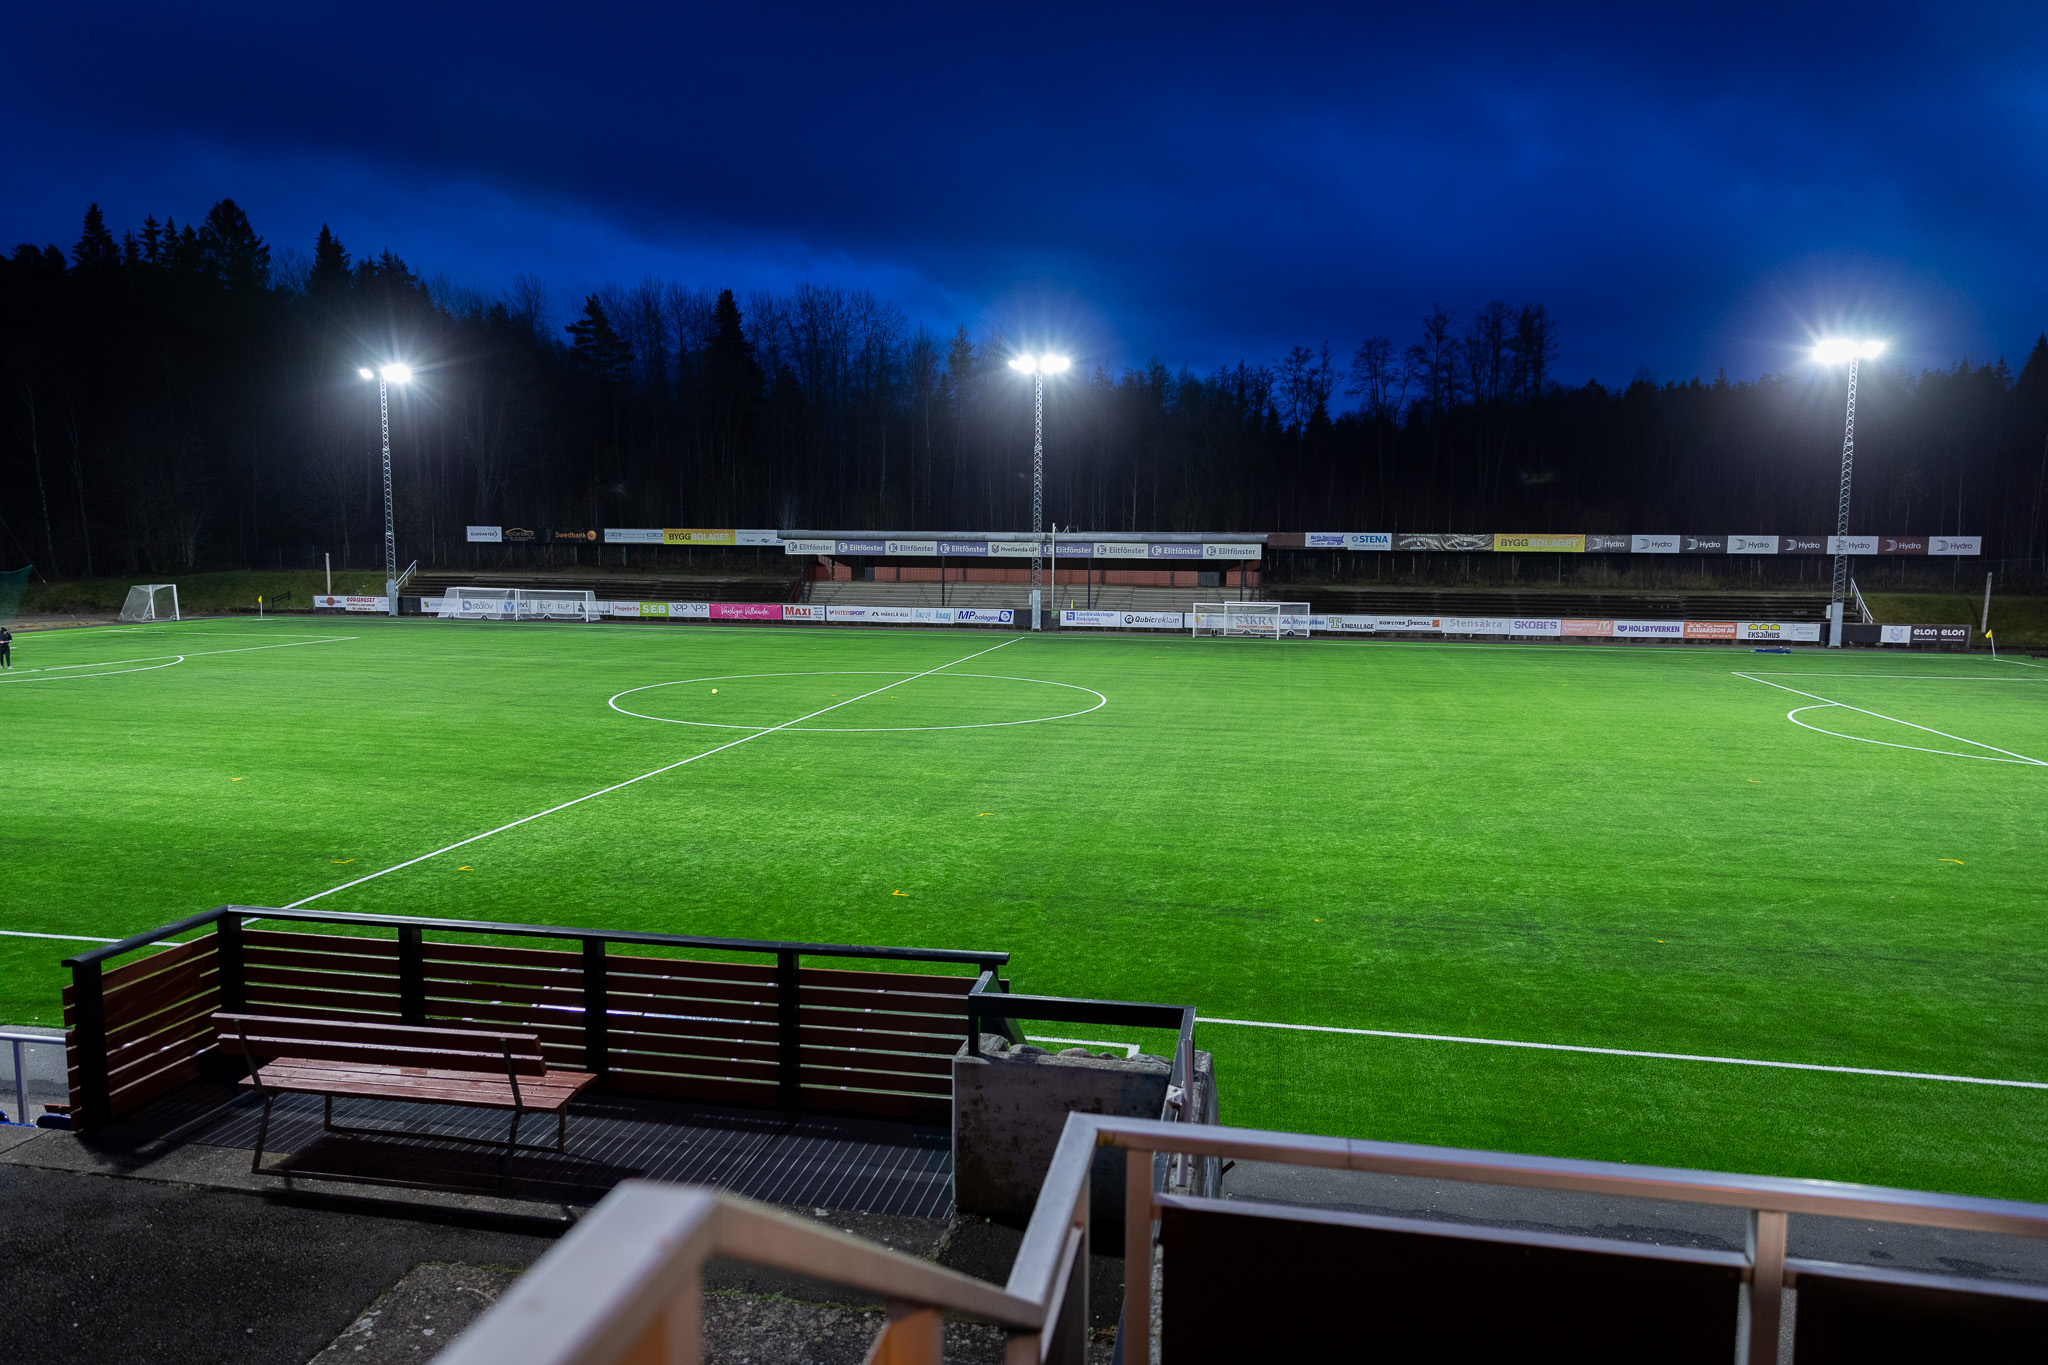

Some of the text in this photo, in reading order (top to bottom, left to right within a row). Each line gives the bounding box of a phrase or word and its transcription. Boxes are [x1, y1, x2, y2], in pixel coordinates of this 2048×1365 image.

[555, 531, 587, 539] Swedbank
[1360, 535, 1388, 544] STENA
[799, 543, 833, 551] Elitfönster
[849, 543, 883, 552] Elitfönster
[900, 544, 934, 552] Elitfönster
[951, 544, 987, 553] Elitfönster
[1748, 541, 1770, 549] Hydro
[1899, 542, 1921, 550] Hydro
[1950, 542, 1973, 550] Hydro
[1056, 546, 1092, 554] Elitfönster
[1108, 546, 1145, 554] Elitfönster
[1163, 547, 1200, 555] Elitfönster
[1218, 547, 1256, 556] Elitfönster
[642, 604, 666, 614] SEB
[1134, 615, 1180, 624] Qubicreklam
[1236, 615, 1274, 625] SÄKRA
[1449, 618, 1502, 628] Stensåkra
[1514, 620, 1557, 630] SKOBES
[1628, 625, 1680, 633] HOLSBYVERKEN
